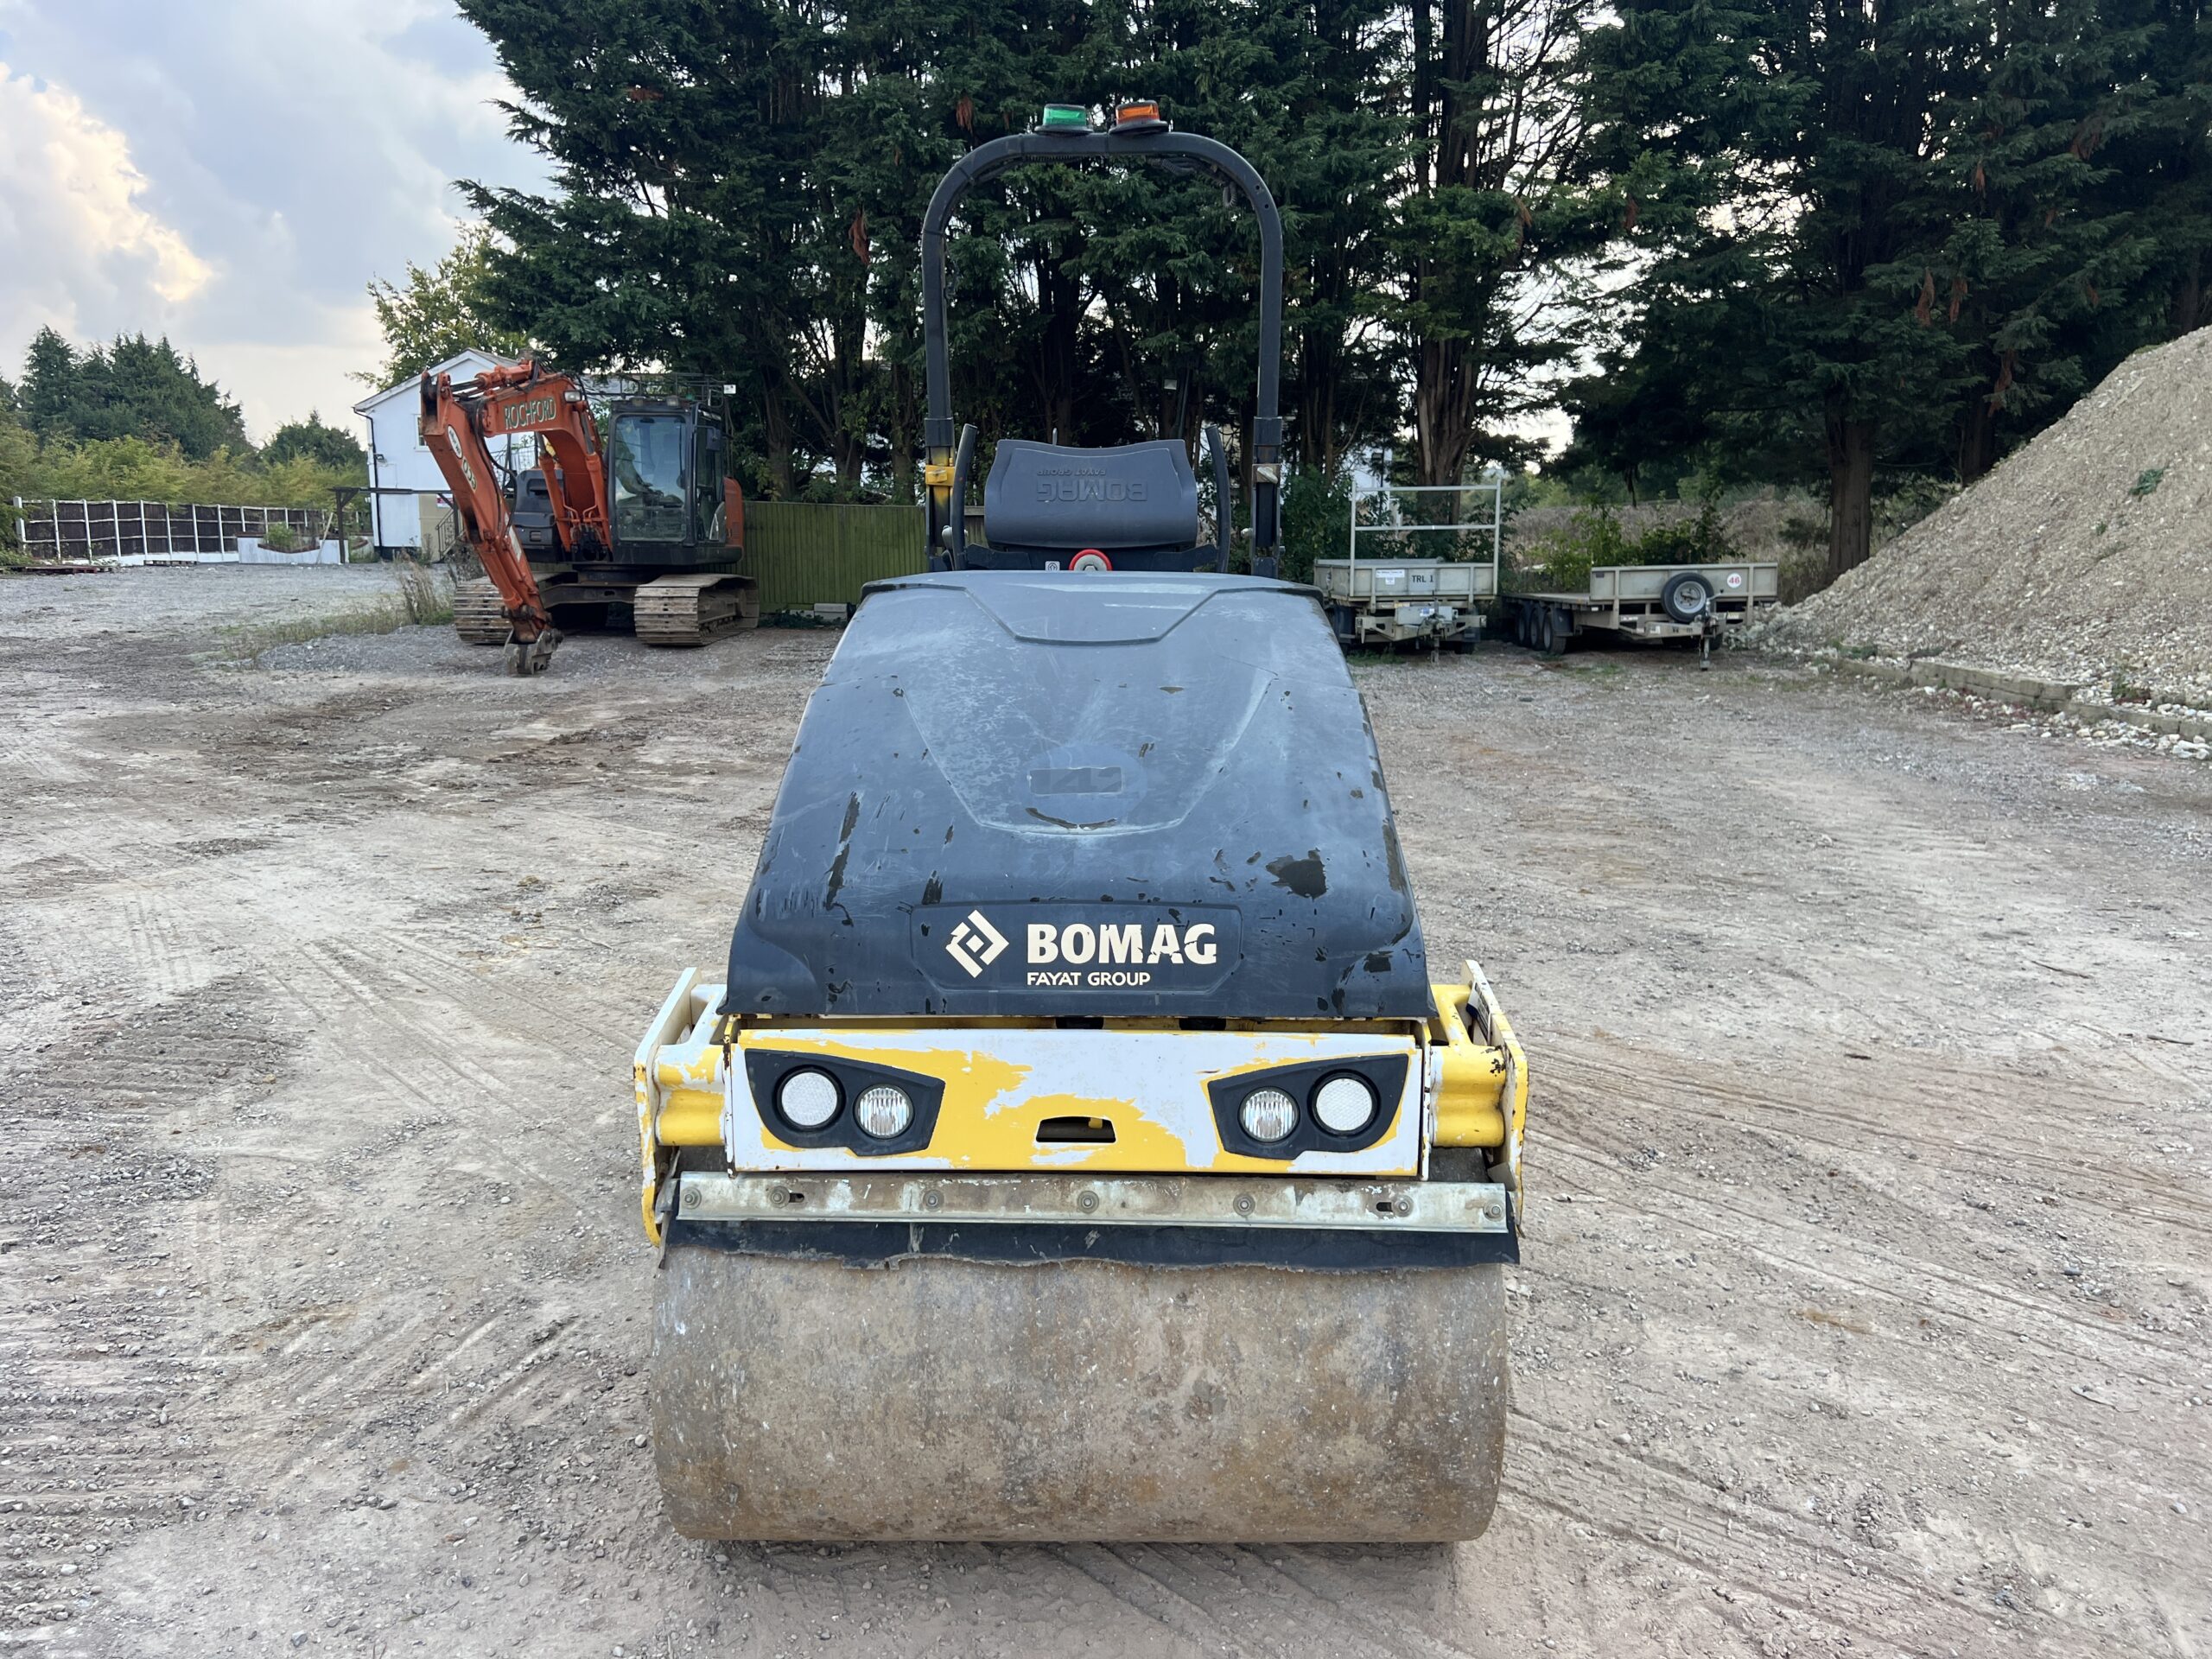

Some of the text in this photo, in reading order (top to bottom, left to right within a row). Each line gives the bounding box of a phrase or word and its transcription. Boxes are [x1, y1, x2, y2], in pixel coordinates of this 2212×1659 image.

[504, 398, 556, 430] ROCHFORD
[1037, 478, 1147, 502] BOMAG
[1412, 575, 1426, 583] TRL
[1027, 923, 1217, 965] BOMAG
[1027, 971, 1151, 986] FAYAT GROUP
